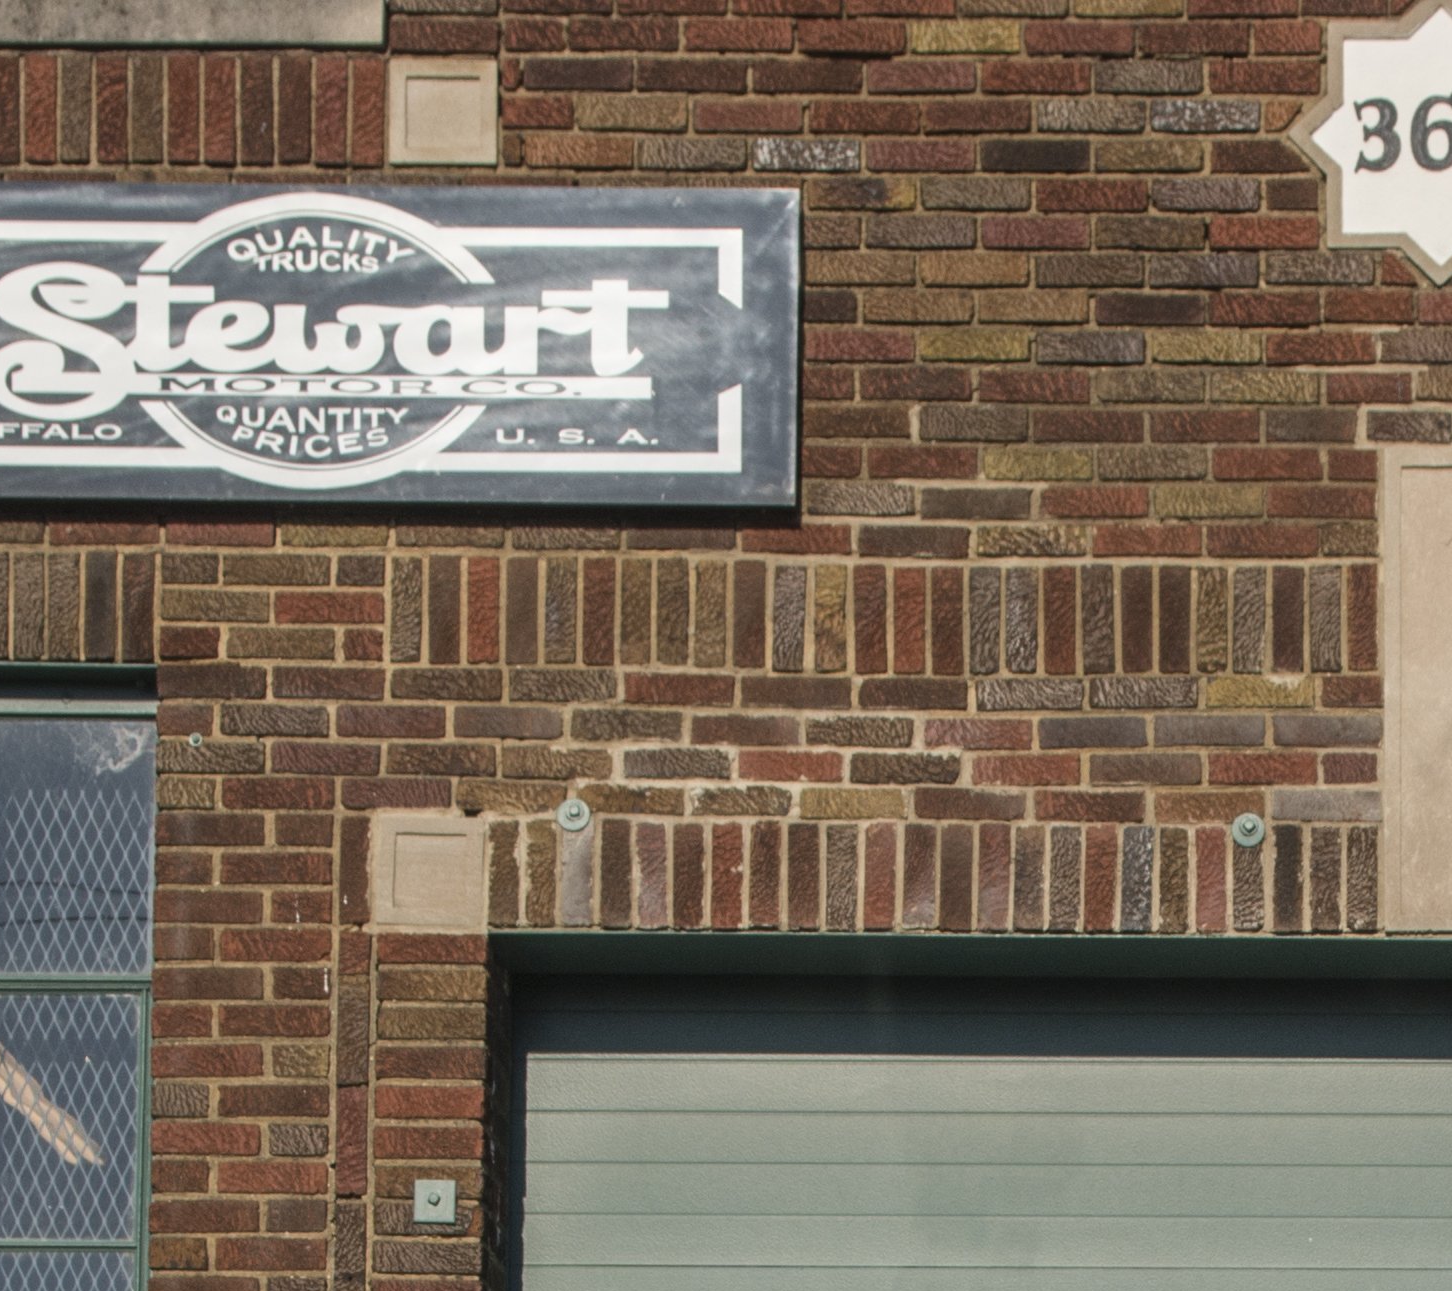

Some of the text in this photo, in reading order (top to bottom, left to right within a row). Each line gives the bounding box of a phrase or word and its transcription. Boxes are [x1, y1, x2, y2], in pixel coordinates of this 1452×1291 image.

[226, 225, 416, 264] QUALITY
[252, 249, 380, 274] TRUCKS
[157, 378, 583, 396] MOTOR CO.
[216, 405, 409, 435] QUANTITY
[232, 424, 390, 458] PRICES
[495, 428, 659, 445] U. S. A.
